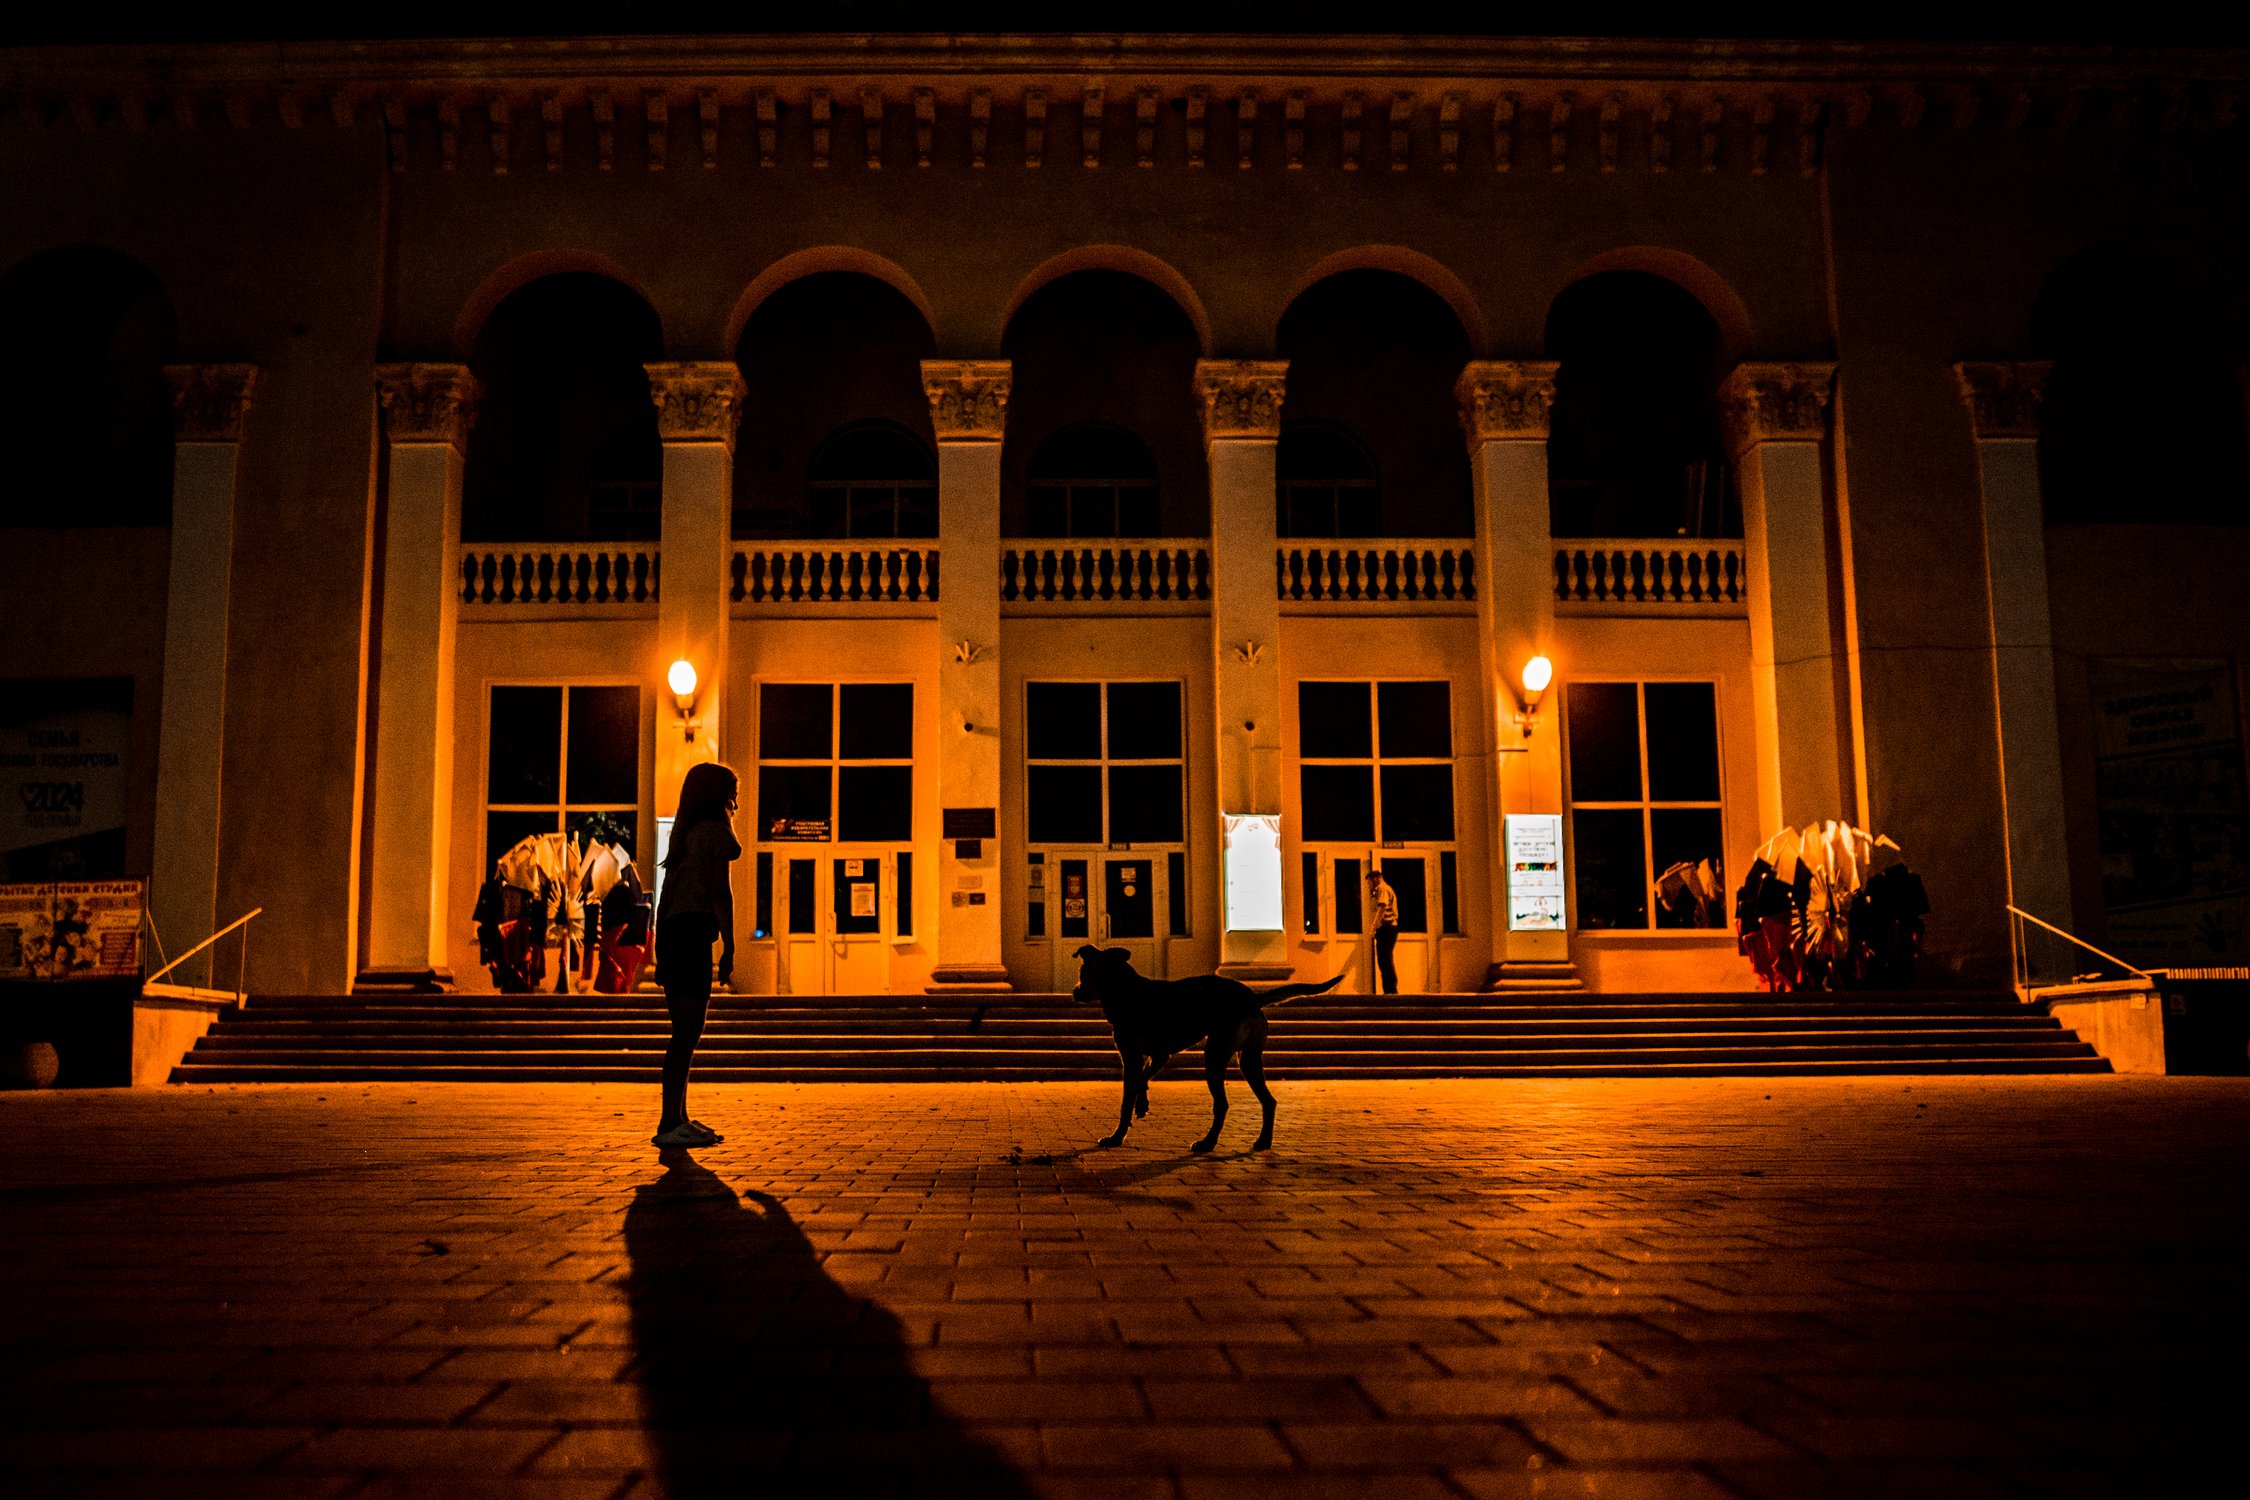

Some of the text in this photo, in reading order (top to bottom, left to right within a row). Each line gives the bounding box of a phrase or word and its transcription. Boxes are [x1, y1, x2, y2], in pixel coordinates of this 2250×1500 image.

[2103, 682, 2213, 715] ЗДОРОВЫЙ
[2130, 706, 2194, 728] ОБРАЗ
[28, 730, 80, 747] СЕМЬЯ
[42, 753, 119, 768] ГОСУДАРСТВА
[24, 781, 84, 812] 2024
